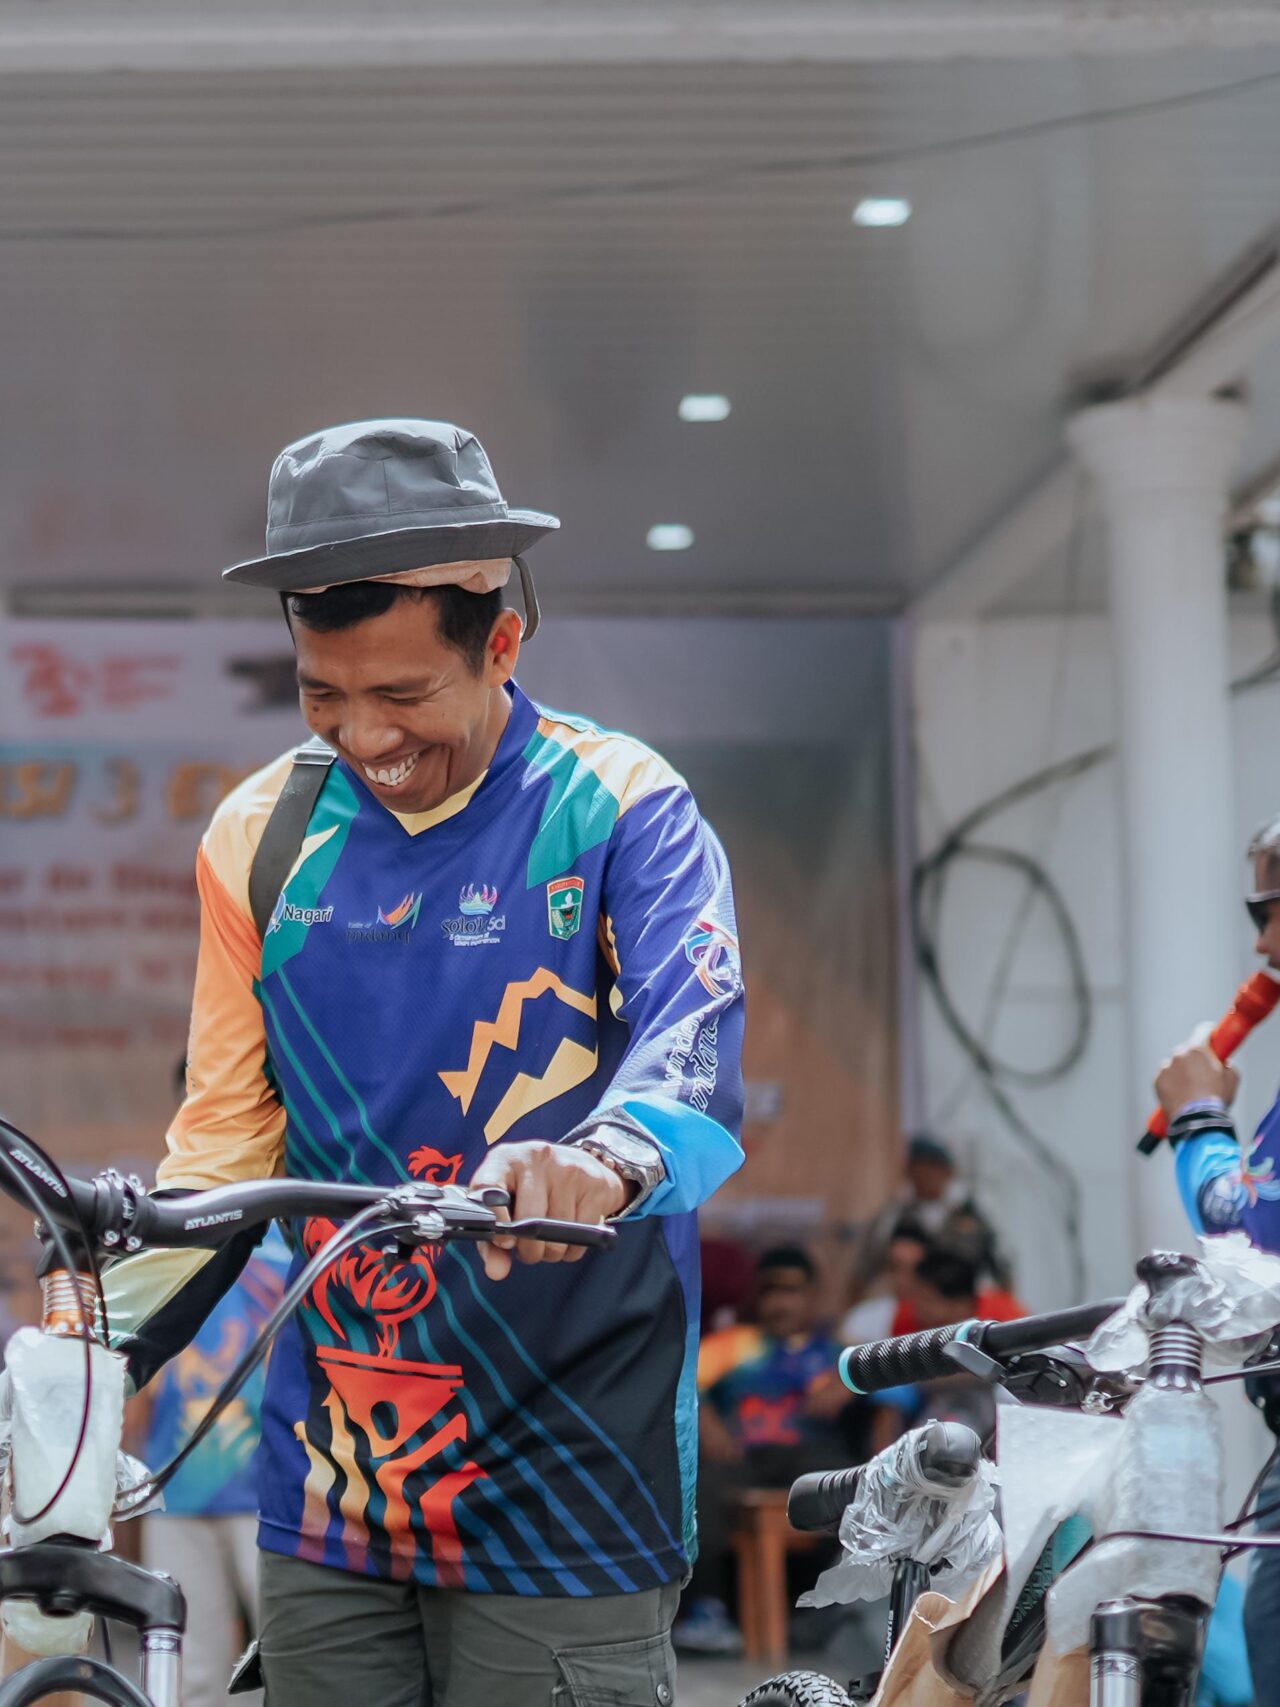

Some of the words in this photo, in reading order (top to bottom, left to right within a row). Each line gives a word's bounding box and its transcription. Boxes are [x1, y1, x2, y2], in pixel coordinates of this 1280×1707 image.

[283, 904, 334, 926] Nagari
[9, 1149, 68, 1198] ATLANTIS
[184, 1209, 244, 1231] ATLANTIS
